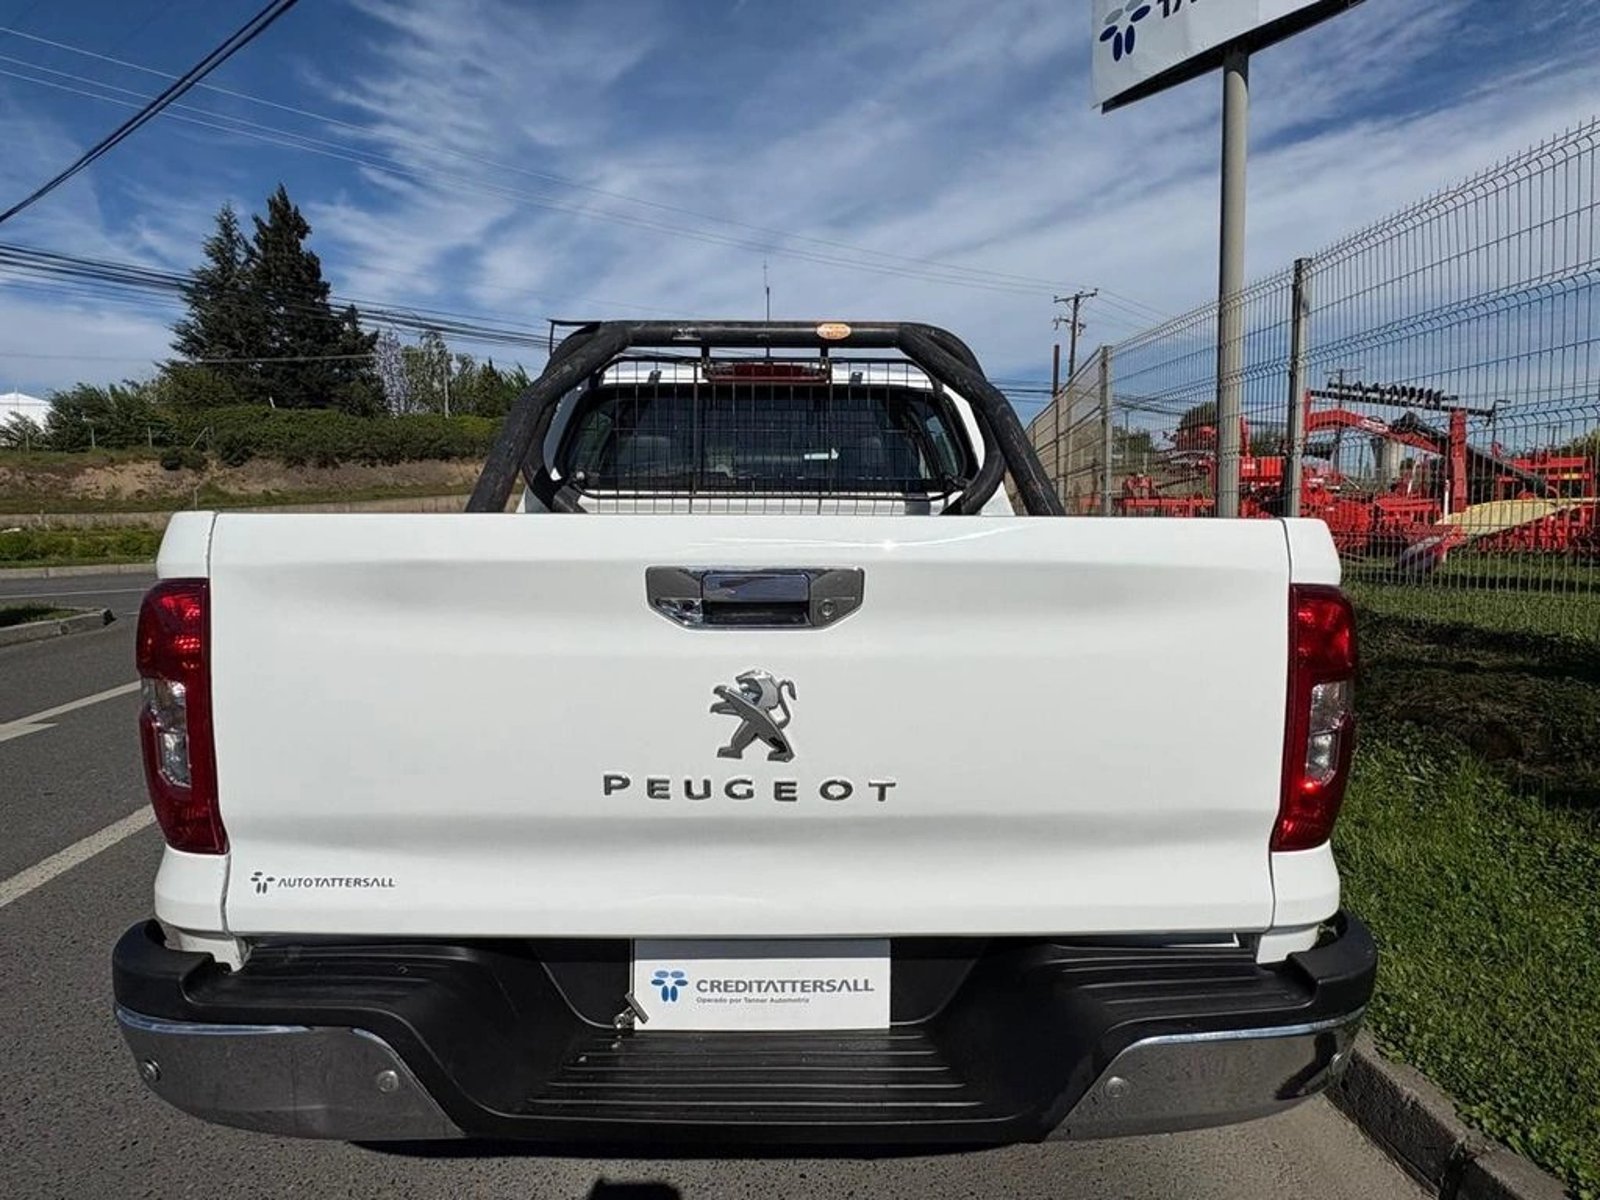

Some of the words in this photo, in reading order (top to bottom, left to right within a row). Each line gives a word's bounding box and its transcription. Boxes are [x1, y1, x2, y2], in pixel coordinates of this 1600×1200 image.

[603, 774, 897, 802] PEUGEOT
[278, 877, 396, 888] AUTOTATTERSALL
[696, 979, 875, 994] CREDITATTERSALL
[729, 997, 742, 1005] por
